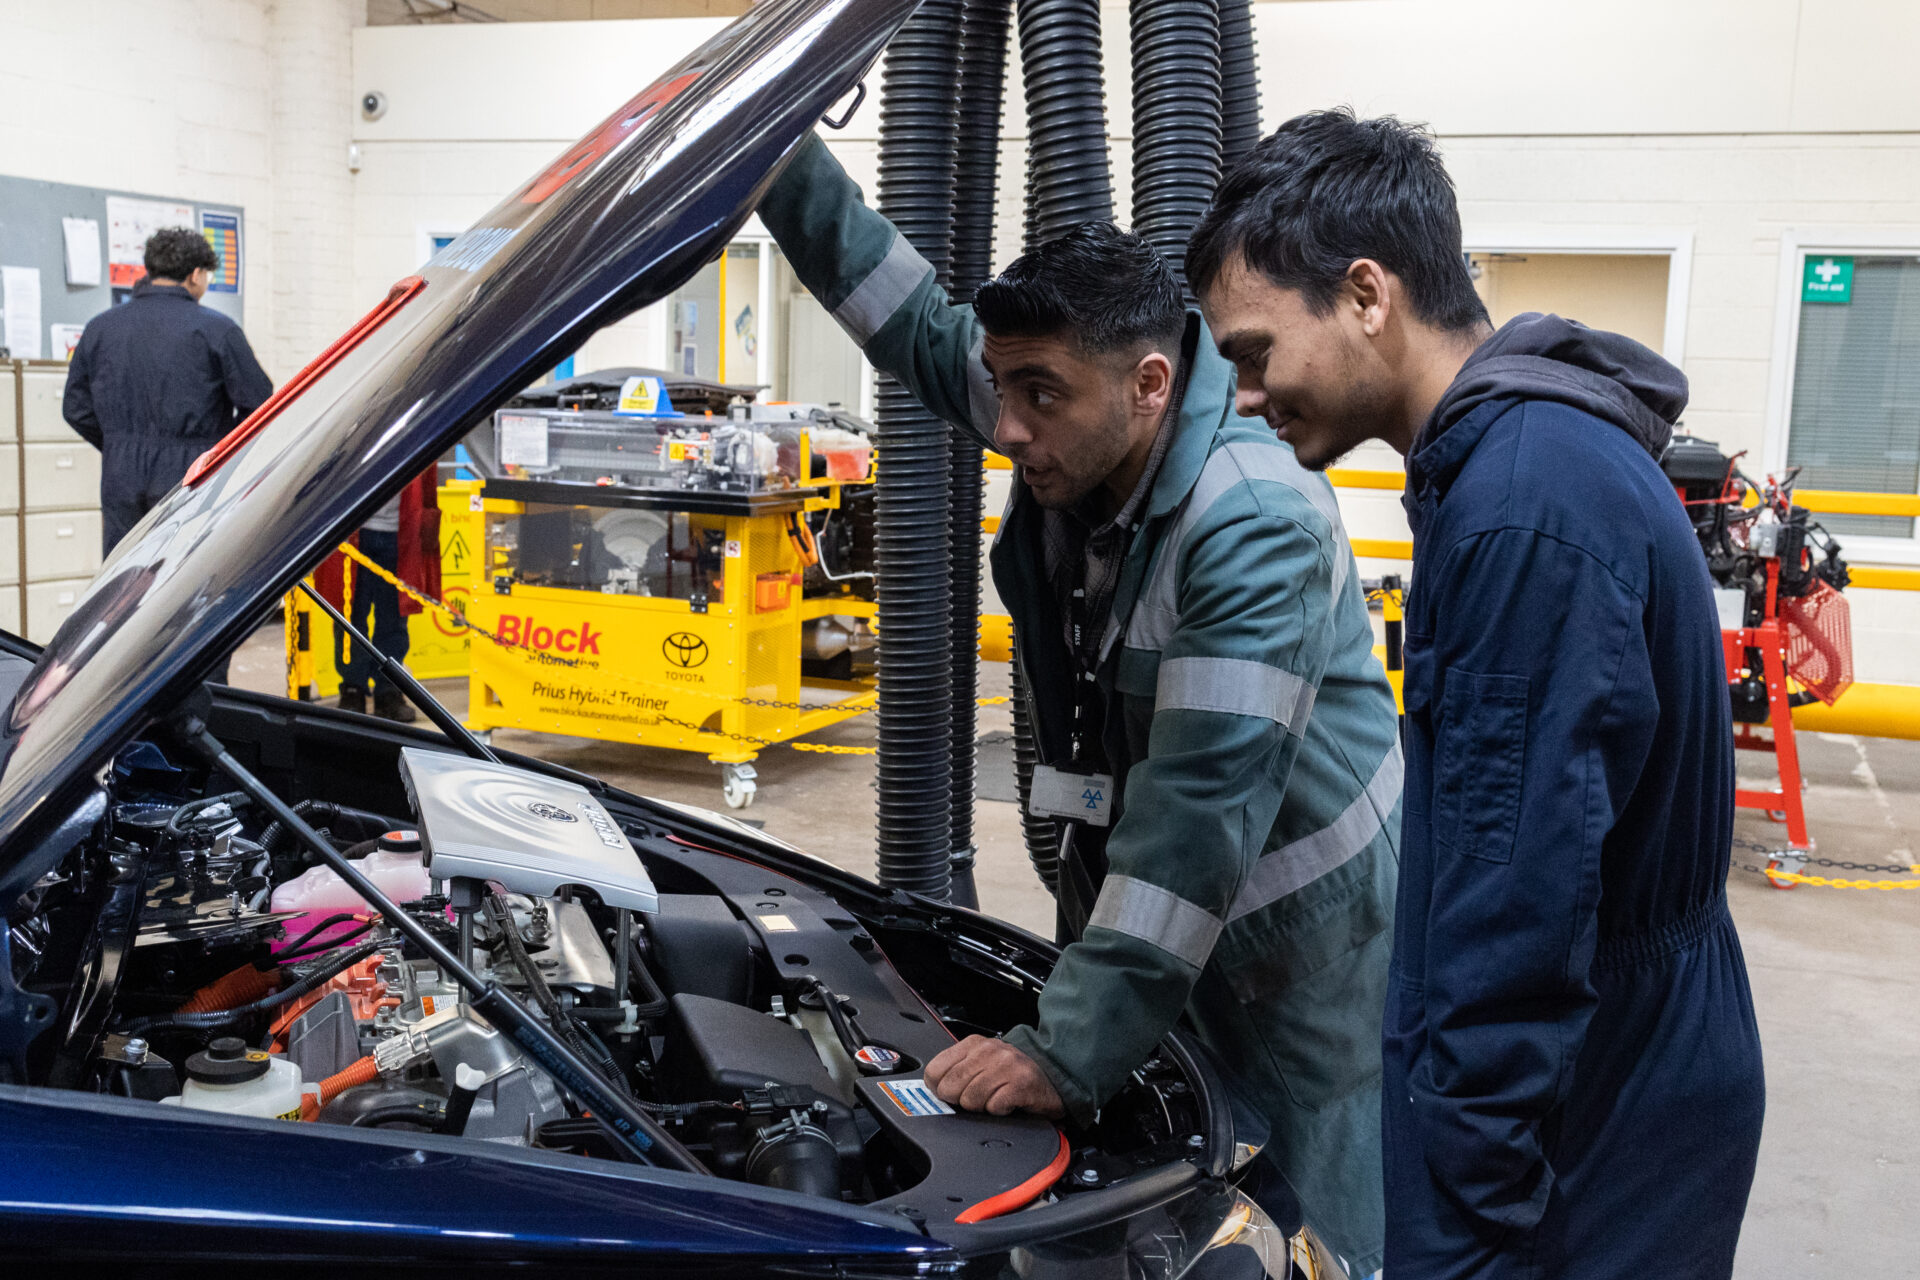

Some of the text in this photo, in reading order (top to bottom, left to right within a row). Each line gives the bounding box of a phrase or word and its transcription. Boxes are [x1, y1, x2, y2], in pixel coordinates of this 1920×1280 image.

[1808, 282, 1845, 291] First aid
[494, 614, 602, 655] Block
[665, 671, 705, 683] TOYOTA
[532, 681, 565, 699] Prius
[621, 691, 669, 711] Trainer
